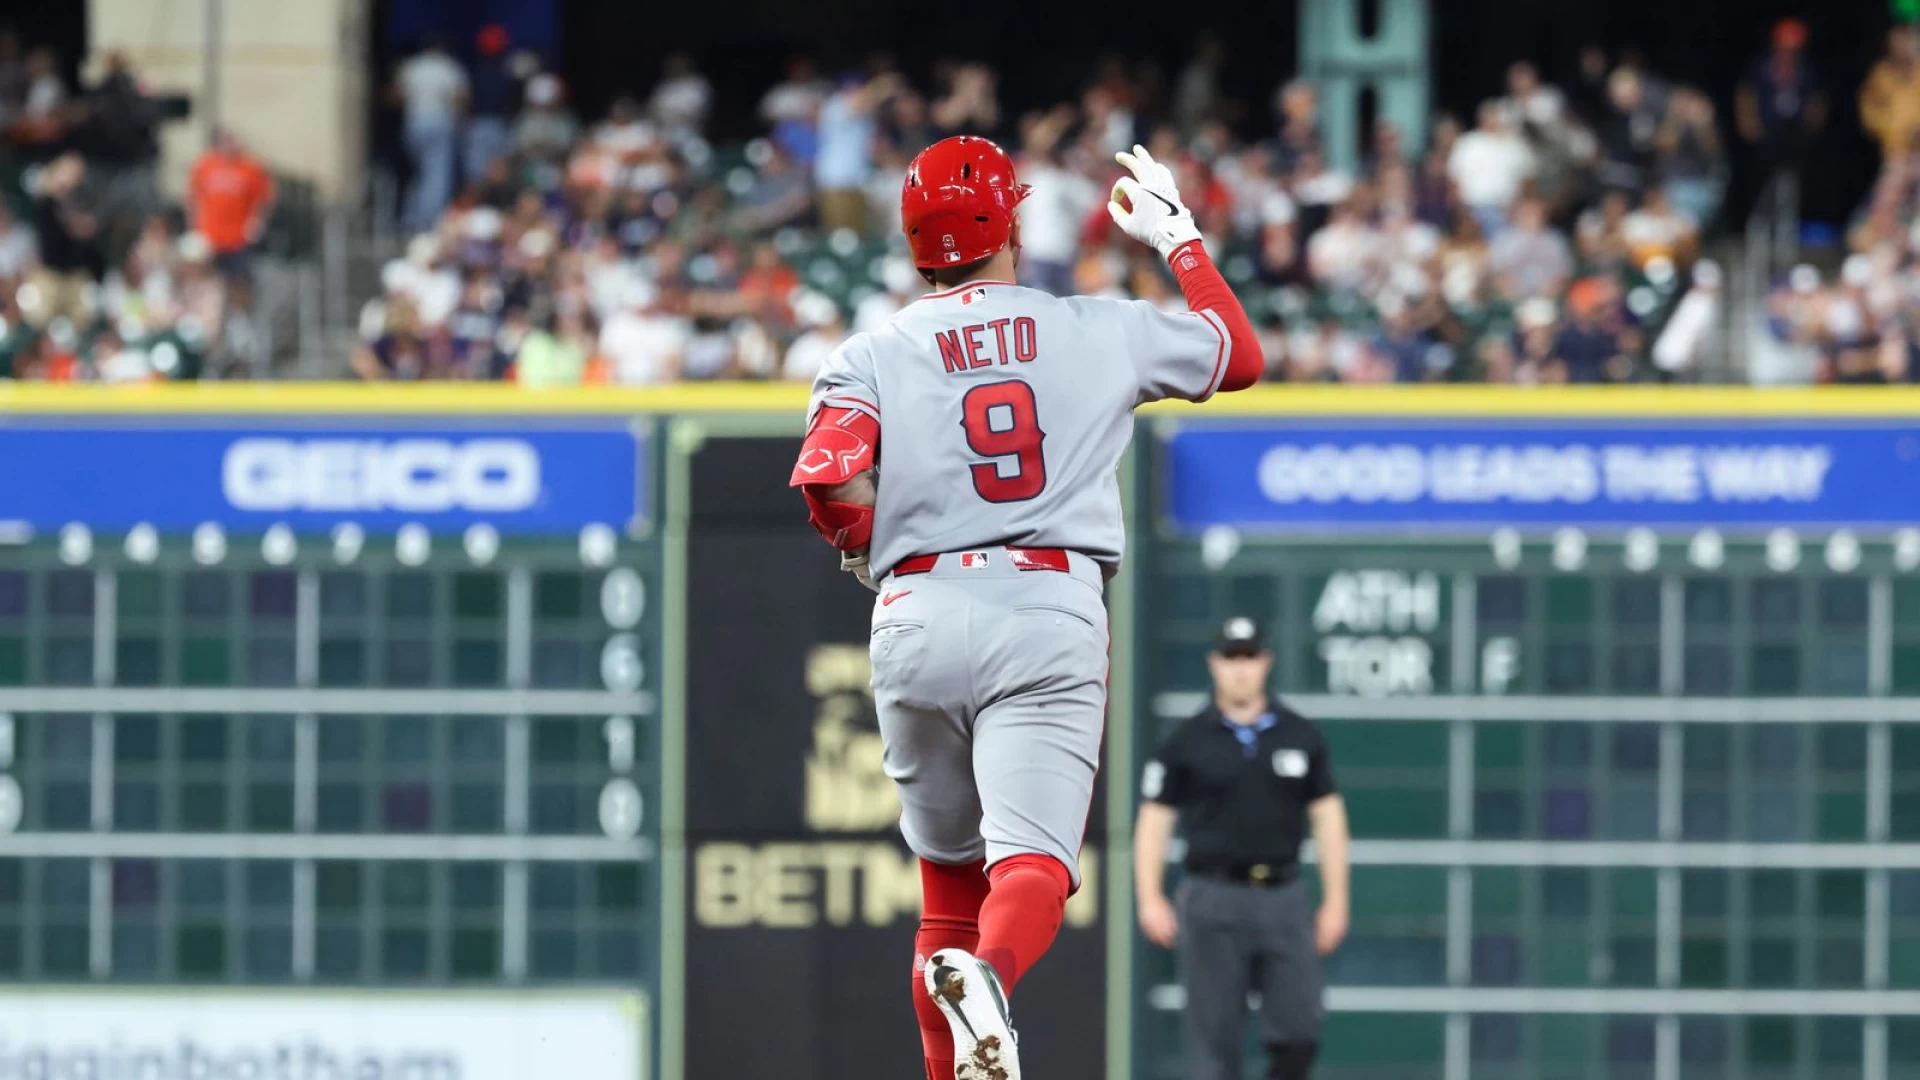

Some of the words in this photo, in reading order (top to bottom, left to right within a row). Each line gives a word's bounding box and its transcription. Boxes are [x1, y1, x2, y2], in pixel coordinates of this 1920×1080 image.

[935, 316, 1038, 373] NETO
[960, 379, 1047, 504] 9
[1259, 445, 1424, 500] GOOD
[1430, 445, 1597, 500] LEADS
[1603, 445, 1699, 500] THE
[1704, 445, 1831, 500] WAY
[223, 439, 540, 511] GEICO
[1313, 569, 1440, 632] ATH
[1318, 635, 1433, 698] TOR
